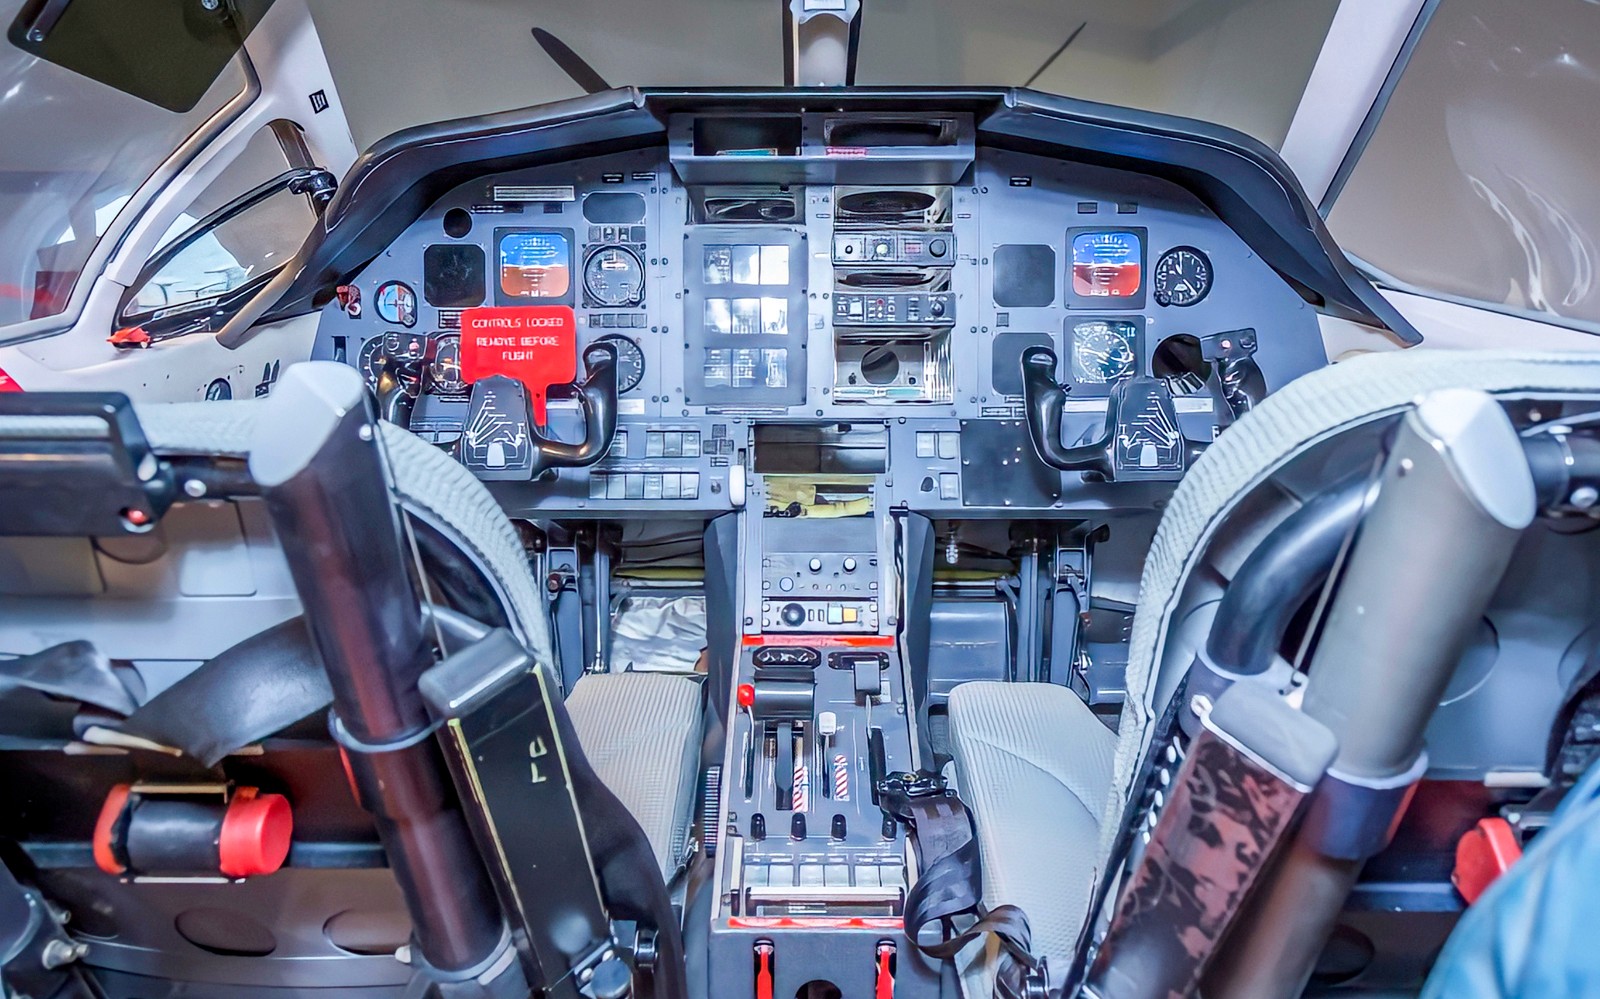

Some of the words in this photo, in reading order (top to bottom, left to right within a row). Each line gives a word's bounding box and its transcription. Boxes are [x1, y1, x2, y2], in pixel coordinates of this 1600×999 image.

[471, 317, 521, 328] CONTROLS
[476, 336, 516, 347] REMOVE
[520, 335, 560, 347] BEFORE
[502, 350, 534, 361] FLIGHT
